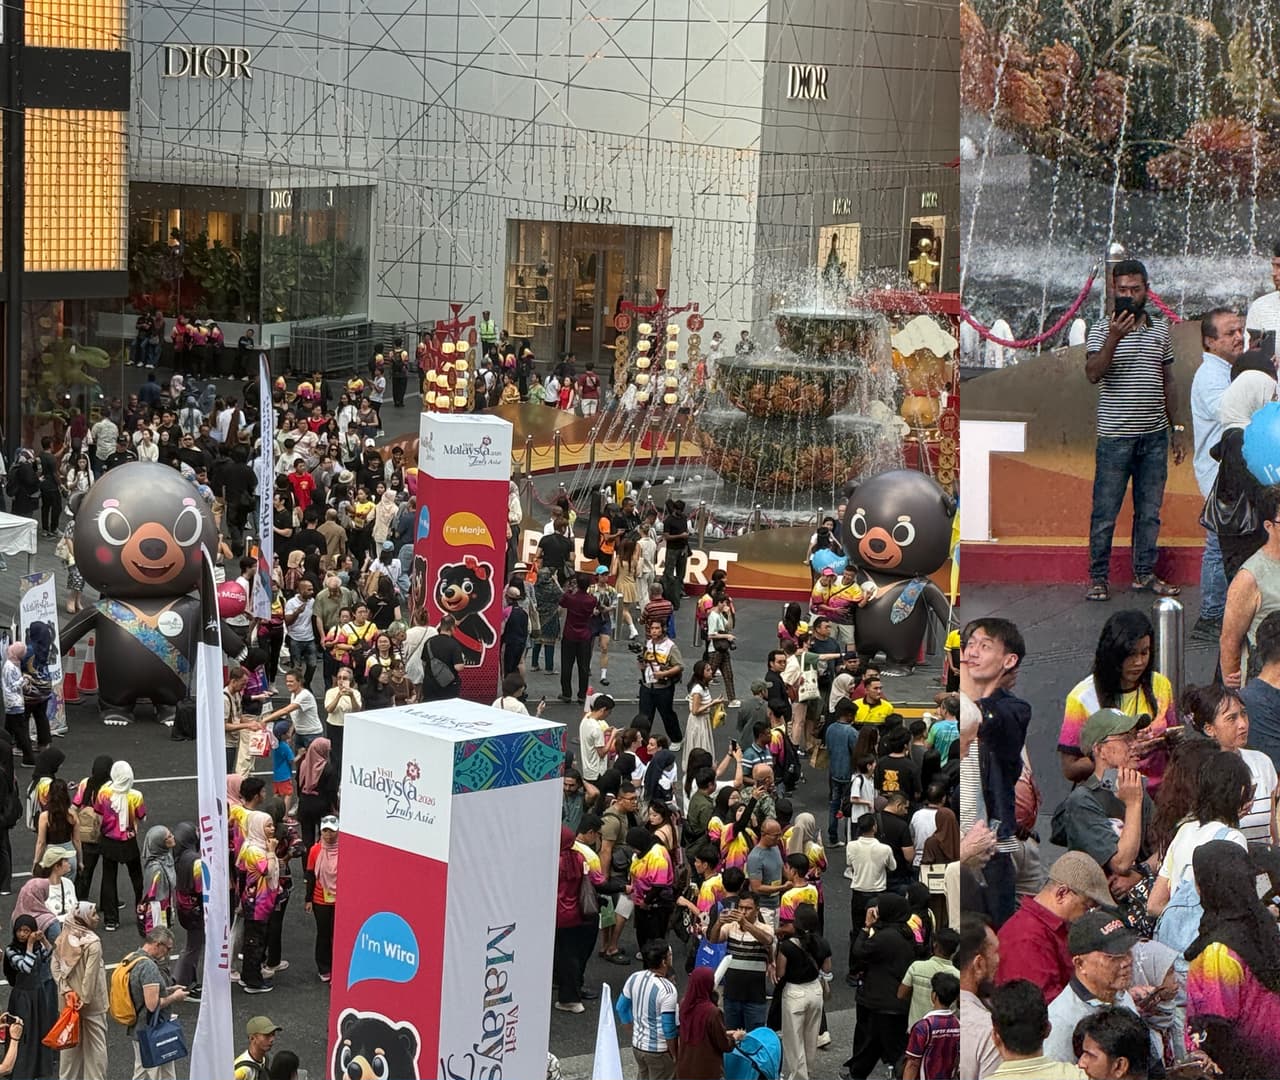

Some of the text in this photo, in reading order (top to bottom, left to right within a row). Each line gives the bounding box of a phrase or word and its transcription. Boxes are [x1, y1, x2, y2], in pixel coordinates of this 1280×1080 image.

[161, 44, 252, 79] DIOR
[786, 64, 829, 100] DIOR
[270, 190, 293, 209] DIO
[563, 195, 612, 213] DIOR
[459, 525, 486, 536] Manja
[350, 764, 436, 806] Malaysia 2026
[377, 767, 393, 778] Visit
[386, 797, 435, 824] Truly Asia
[361, 933, 415, 965] I'm Wira
[505, 1004, 519, 1053] Visit
